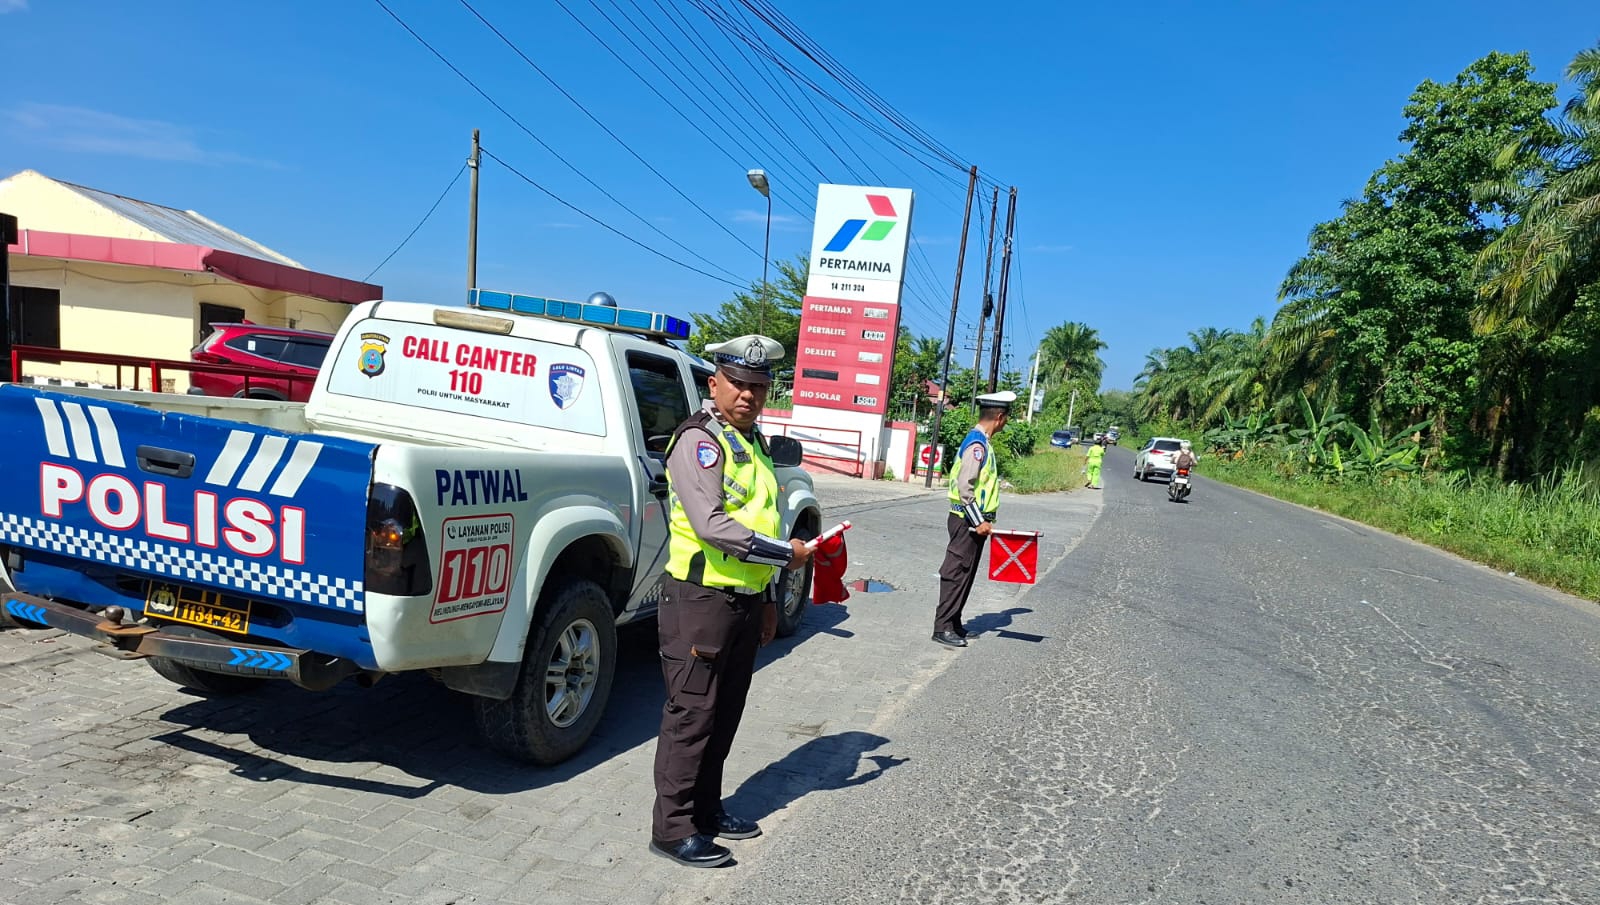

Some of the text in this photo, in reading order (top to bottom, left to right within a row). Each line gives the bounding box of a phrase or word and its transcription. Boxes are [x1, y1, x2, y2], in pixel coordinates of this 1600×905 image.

[819, 257, 891, 273] PERTAMINA
[831, 282, 838, 290] 14
[809, 303, 853, 315] PERTAMAX
[807, 325, 846, 336] PERTALITE
[402, 335, 537, 377] CALL CANTER
[804, 347, 837, 357] DEXLITE
[448, 369, 483, 395] 110
[417, 387, 511, 409] POLRI UNTUK MASYARAKAT
[800, 390, 841, 402] BIO SOLAR
[435, 468, 528, 506] PATWAL
[40, 461, 305, 565] POLISI
[457, 521, 511, 538] LAYANAN POLISI
[448, 547, 507, 598] 110
[181, 602, 241, 630] 1134-42
